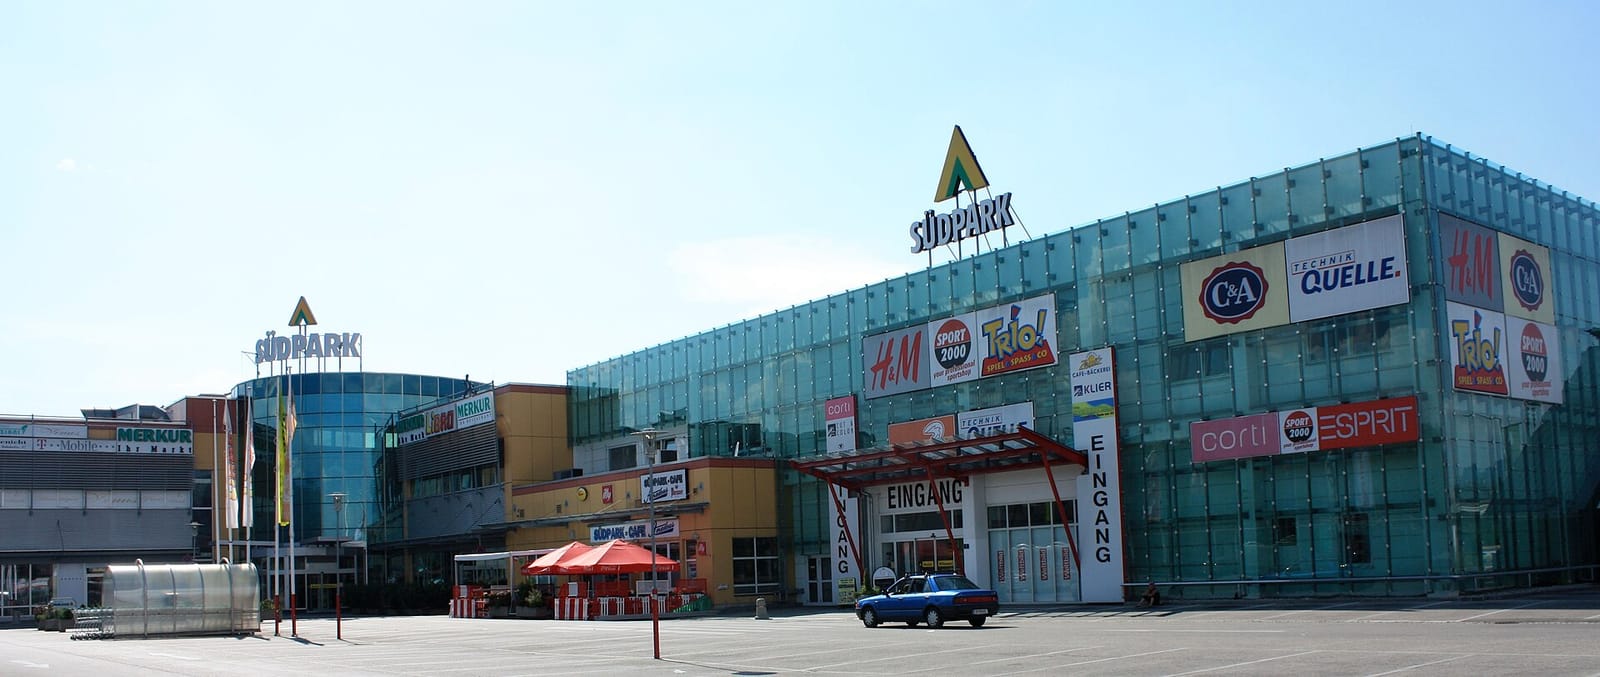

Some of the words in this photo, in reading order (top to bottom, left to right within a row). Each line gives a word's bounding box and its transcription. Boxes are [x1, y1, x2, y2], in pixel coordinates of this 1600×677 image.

[909, 192, 1015, 254] SÜDPARK
[1294, 253, 1353, 270] TECHNIK
[1448, 228, 1493, 300] H&M
[1516, 265, 1539, 296] C&A
[1211, 276, 1257, 308] C&A
[255, 330, 361, 364] SÜDPARK
[936, 328, 967, 347] SPORT
[1522, 336, 1545, 353] SPORT
[870, 330, 922, 391] H&M
[941, 344, 967, 362] 2000
[987, 361, 1005, 372] SPIEL
[1010, 354, 1032, 366] SPASS
[1037, 349, 1048, 359] CO
[1525, 355, 1545, 373] 2000
[1083, 381, 1112, 394] KLIER
[457, 397, 491, 417] MERKUR
[828, 402, 851, 415] corti
[962, 415, 1001, 426] TECHNIK
[1285, 417, 1310, 428] SPORT
[1319, 405, 1413, 441] ESPRIT
[118, 428, 192, 443] MERKUR
[1201, 424, 1267, 452] corti
[1288, 427, 1310, 438] 2000
[888, 479, 962, 509] EINGANG
[1090, 435, 1111, 563] EINGANG
